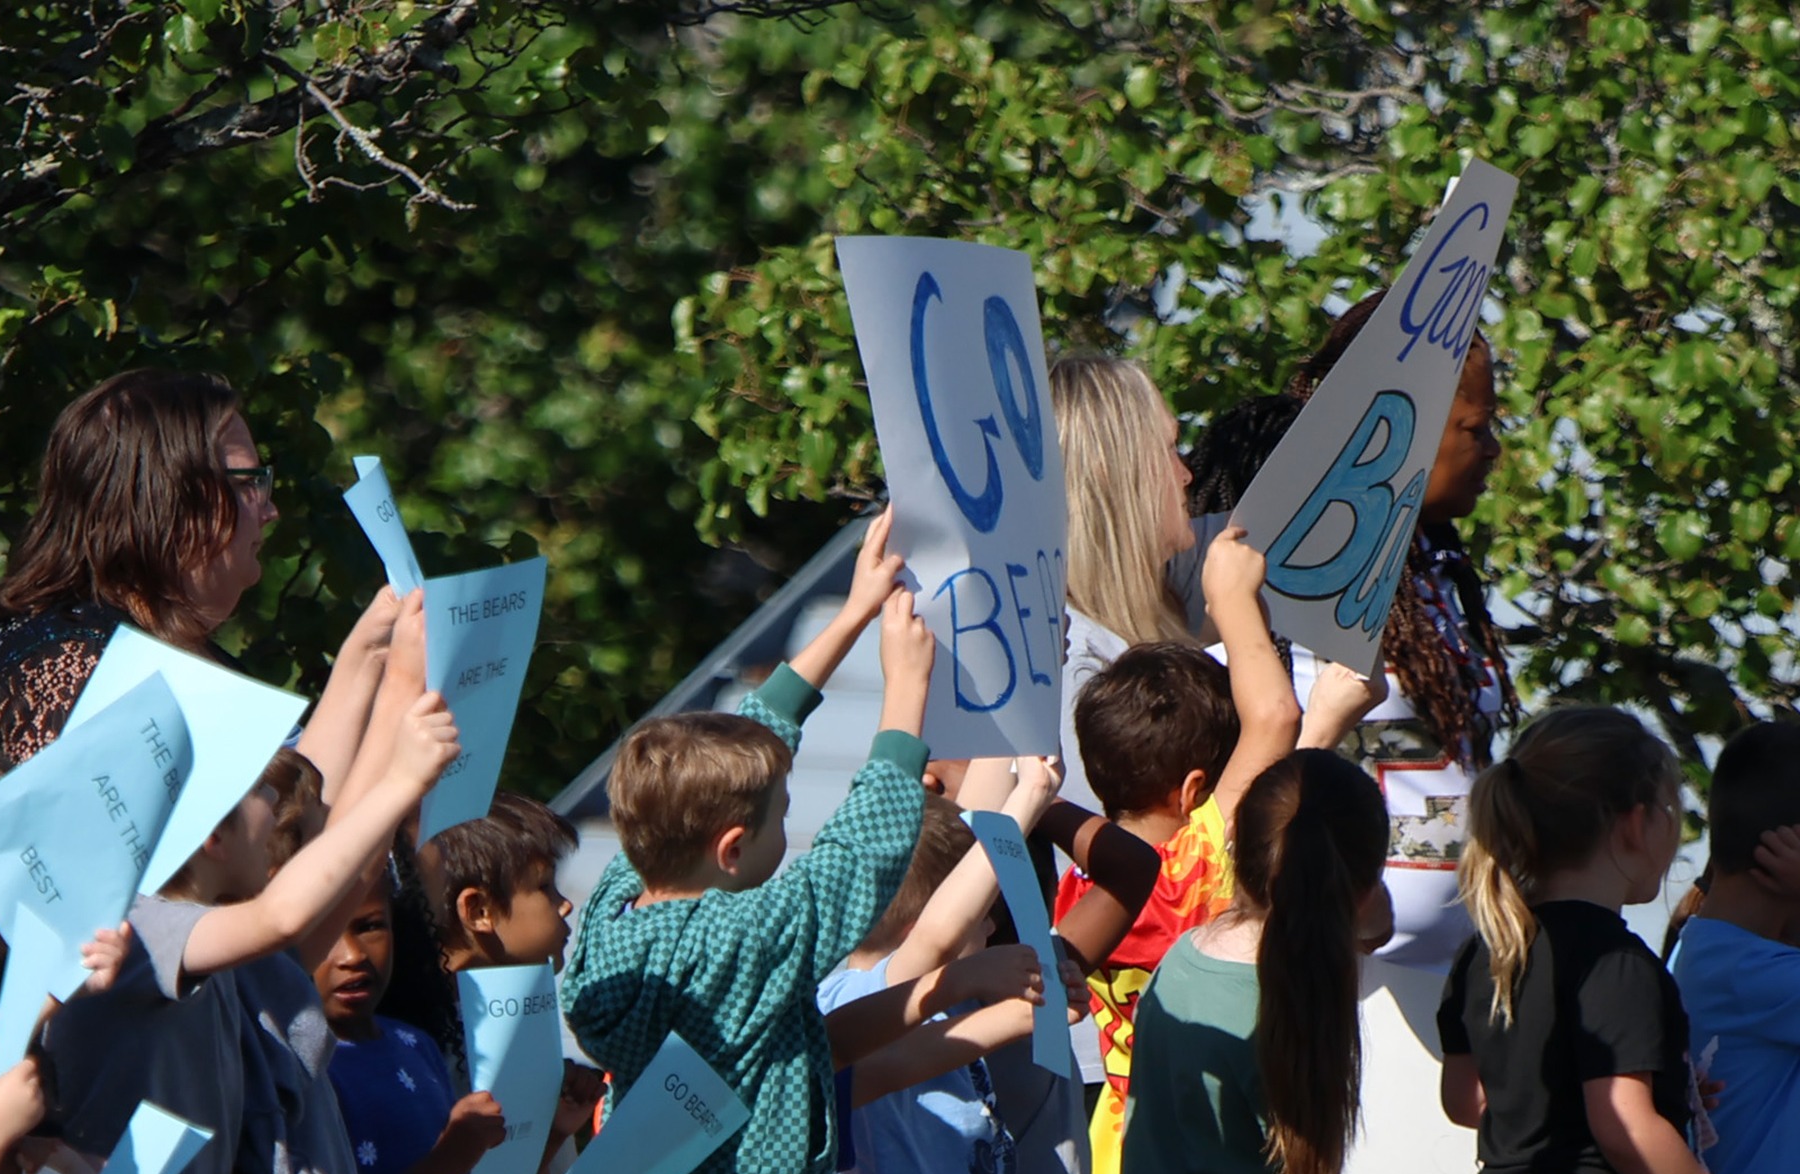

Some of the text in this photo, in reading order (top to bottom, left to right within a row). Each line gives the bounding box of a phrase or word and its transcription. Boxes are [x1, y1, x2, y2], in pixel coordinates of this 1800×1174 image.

[909, 271, 1044, 534] GO
[376, 499, 395, 523] GO
[448, 590, 526, 626] THE BEARS
[458, 657, 509, 690] ARE THE
[141, 717, 173, 769] THE
[91, 774, 150, 871] ARE THE
[20, 844, 62, 905] BEST
[489, 997, 519, 1018] GO
[664, 1073, 689, 1101] GO
